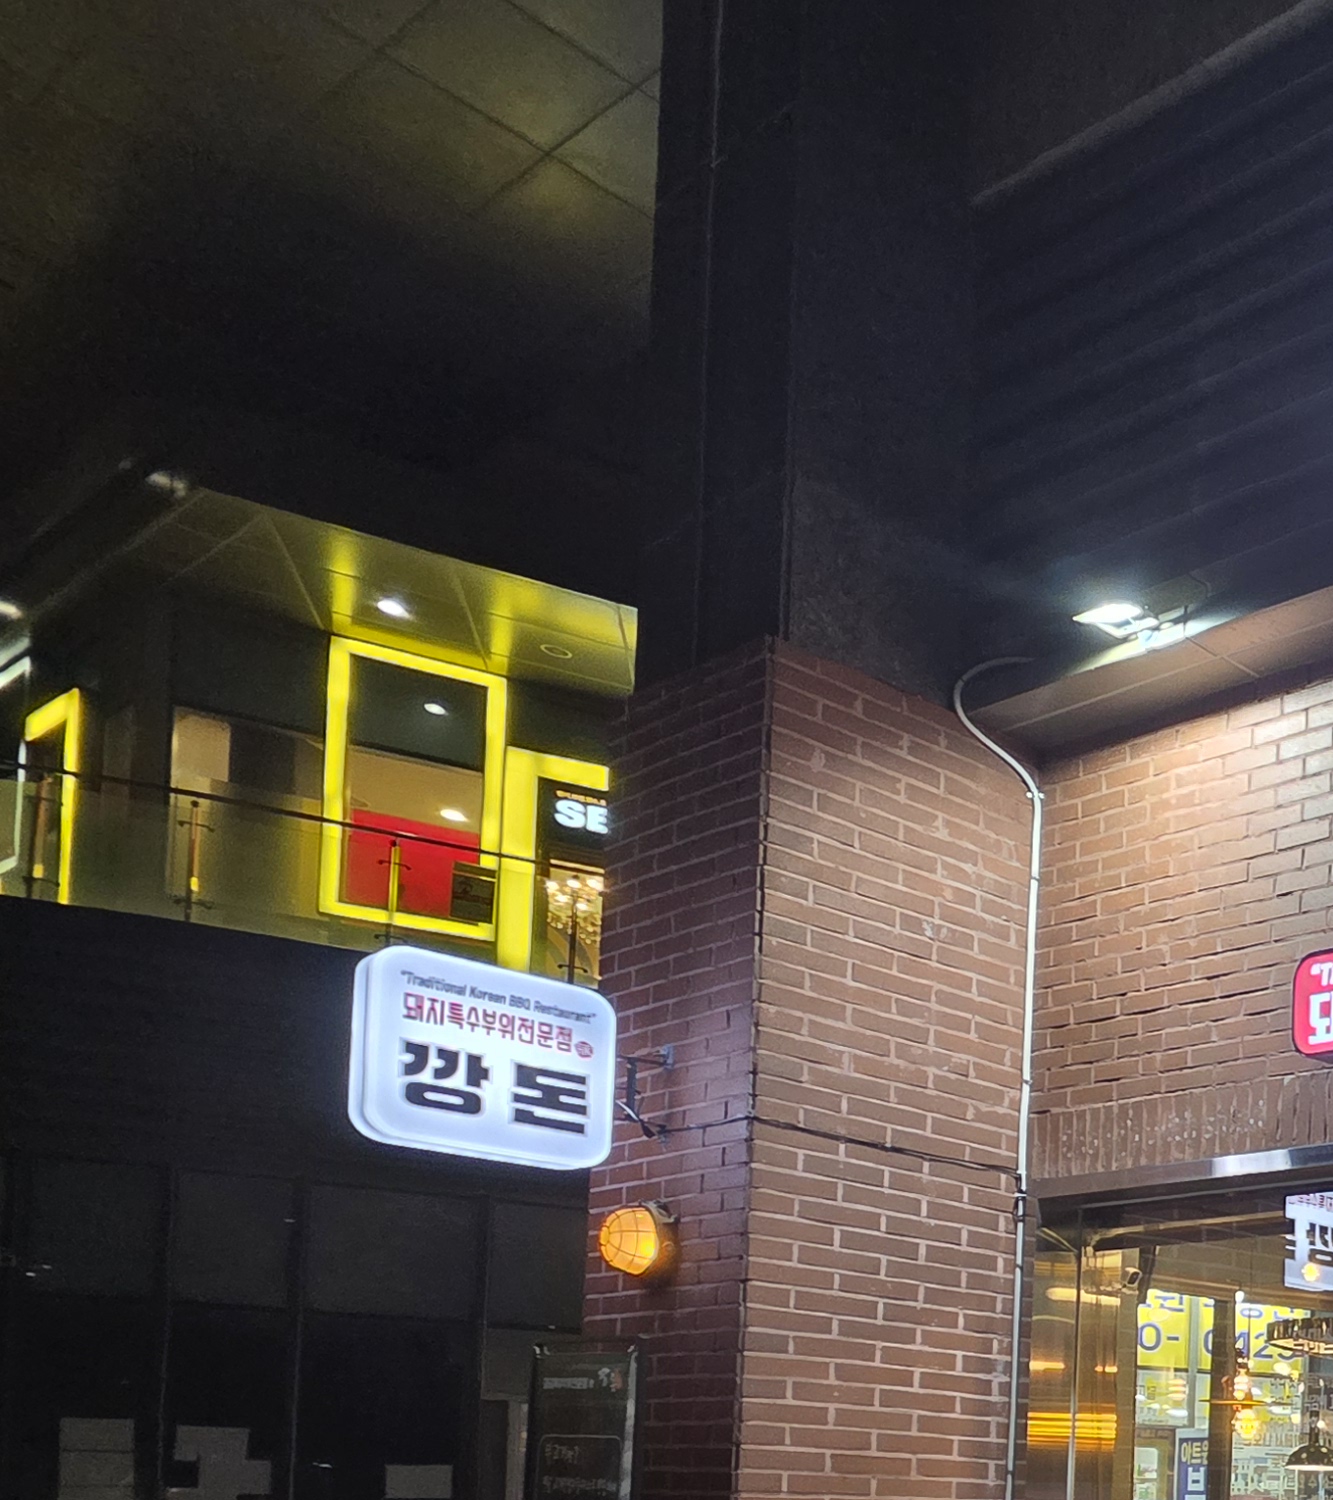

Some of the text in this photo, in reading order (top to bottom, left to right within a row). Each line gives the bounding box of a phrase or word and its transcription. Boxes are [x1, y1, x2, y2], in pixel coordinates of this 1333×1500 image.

[469, 984, 508, 1006] Korean
[509, 993, 532, 1013] BBQ
[402, 991, 574, 1054] 돼지특수부위전문점
